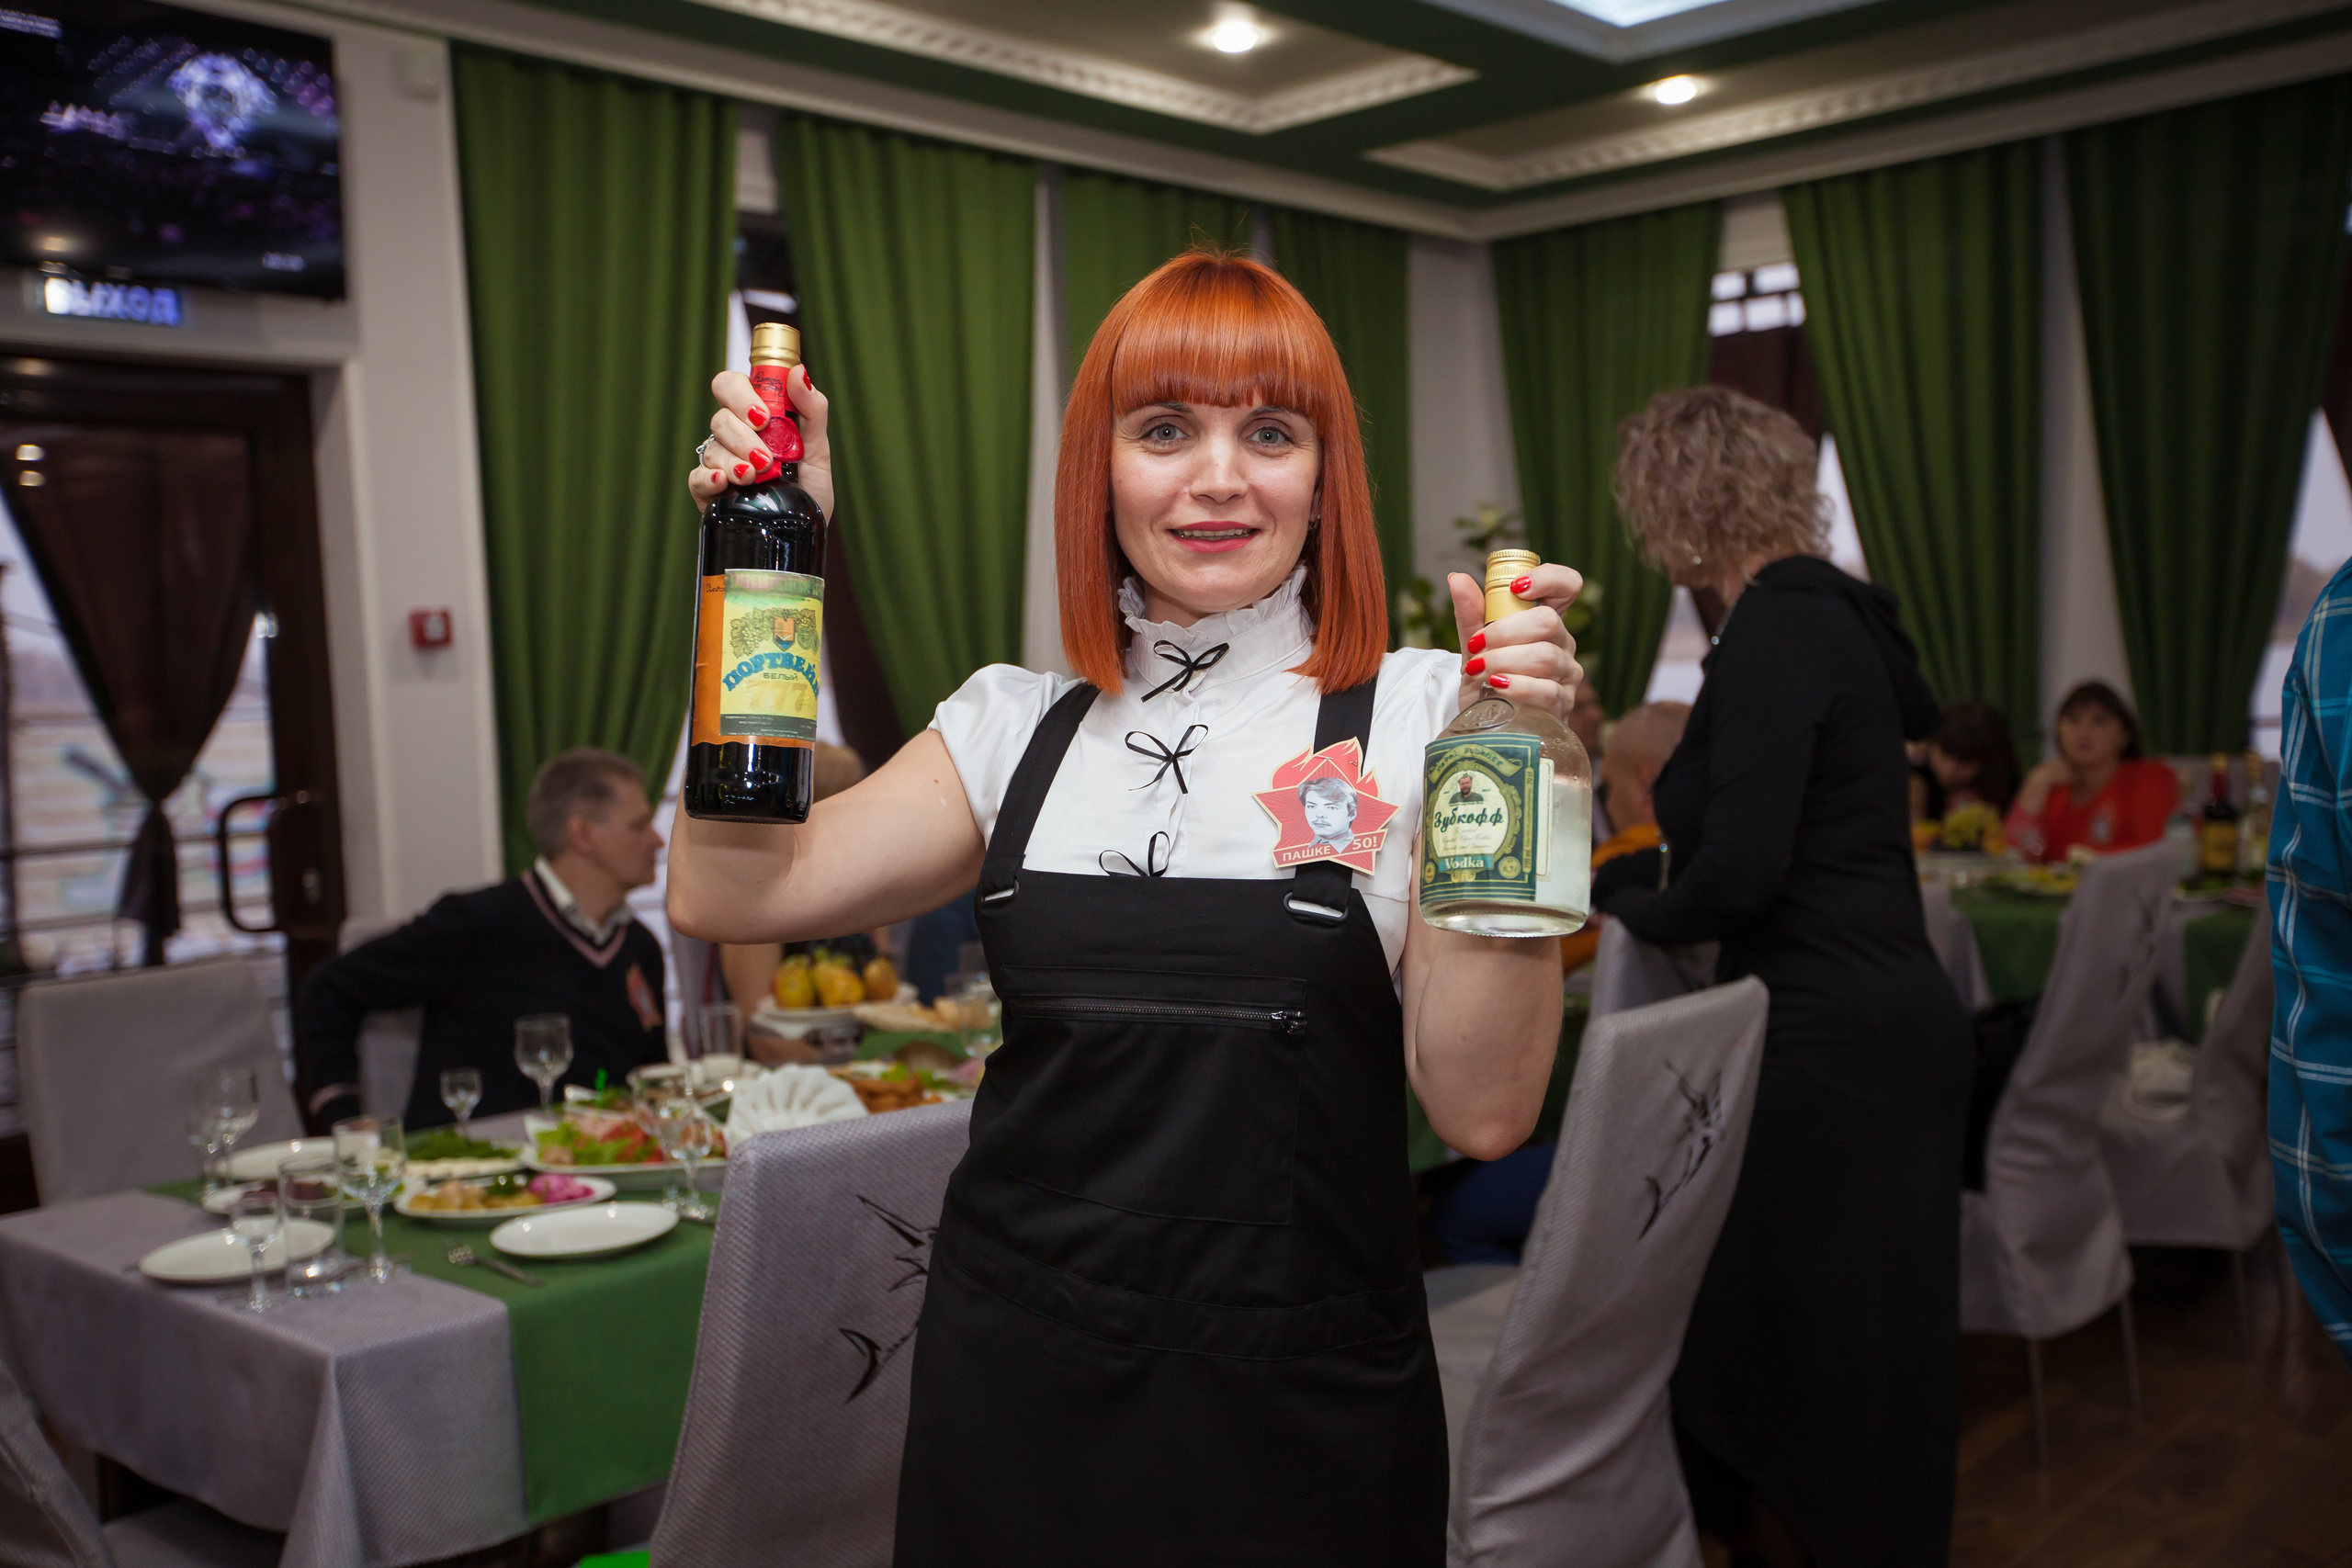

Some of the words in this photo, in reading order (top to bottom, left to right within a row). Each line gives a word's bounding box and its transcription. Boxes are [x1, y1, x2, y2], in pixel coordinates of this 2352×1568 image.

[45, 276, 181, 326] ВЫХОД
[763, 672, 798, 682] БЕЛЫЙ
[746, 680, 808, 713] 777
[1434, 807, 1504, 833] Зубкофф
[1283, 845, 1331, 862] ПАШКЕ
[1352, 836, 1377, 851] 50!
[1444, 855, 1485, 870] Vodka
